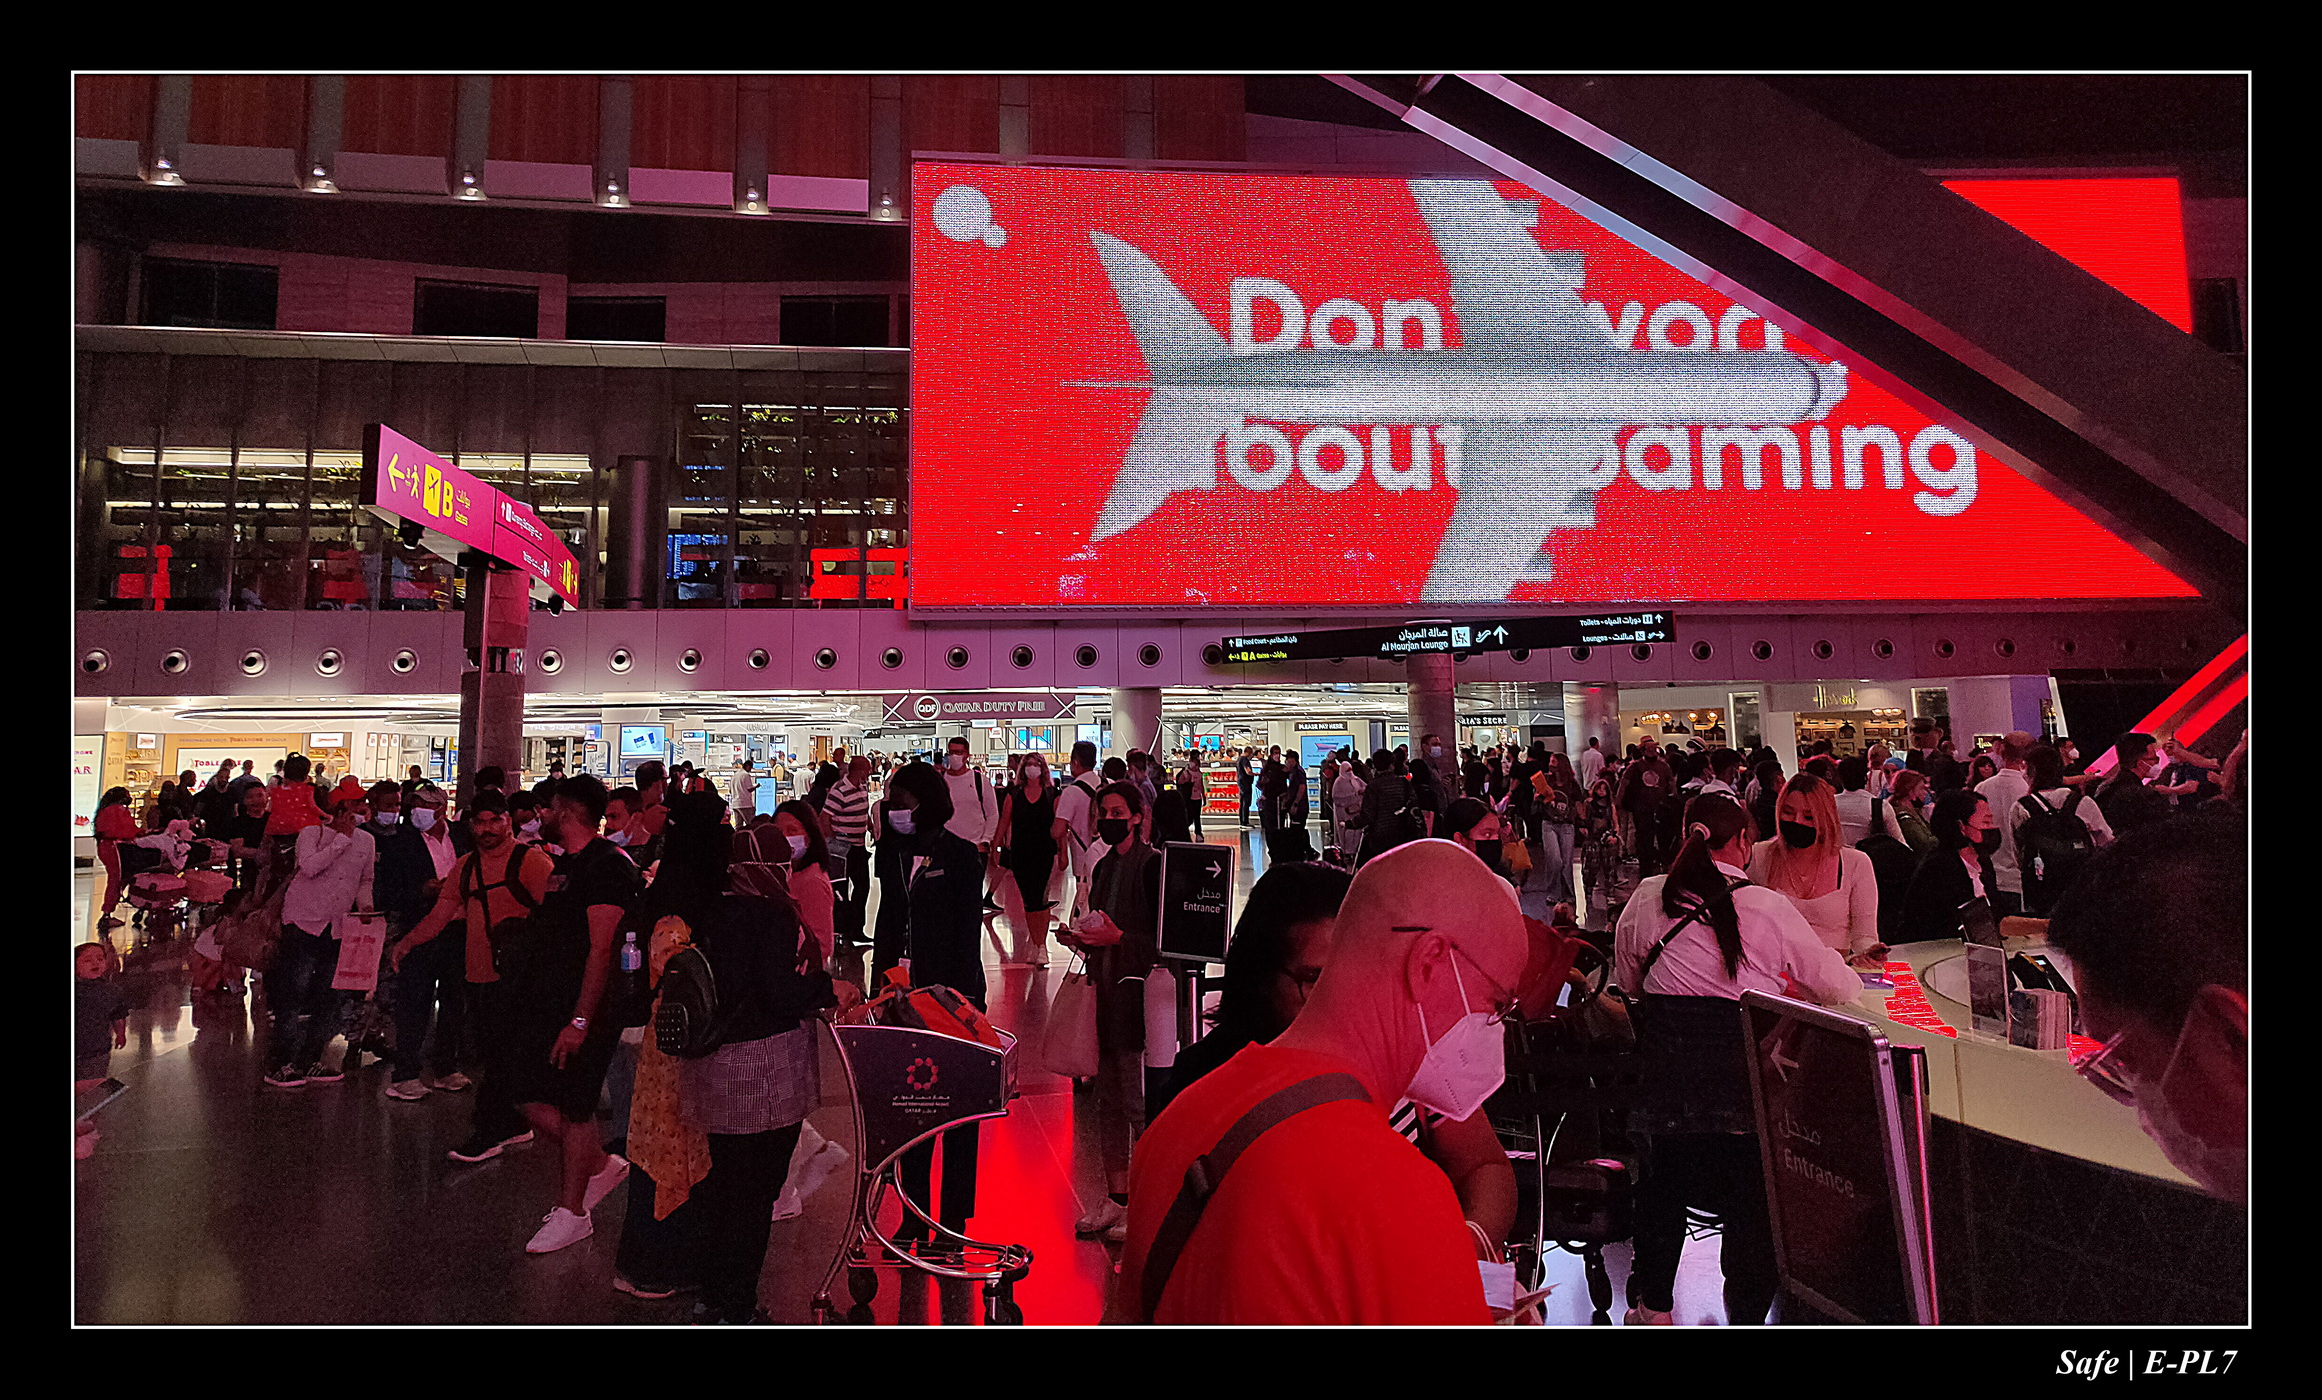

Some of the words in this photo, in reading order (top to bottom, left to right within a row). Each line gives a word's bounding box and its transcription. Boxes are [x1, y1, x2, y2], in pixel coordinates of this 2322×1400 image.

[442, 480, 454, 518] B
[1398, 628, 1427, 642] المرجان
[1427, 627, 1449, 639] صالة
[1582, 635, 1608, 643] Lounges
[1381, 642, 1390, 652] Al
[1390, 641, 1420, 653] Mourjan
[1420, 639, 1449, 651] Lounge
[1249, 651, 1257, 661] A
[918, 704, 936, 714] QDF
[943, 702, 983, 713] QATAR
[984, 702, 1017, 712] DUTY
[1018, 701, 1046, 711] FREE
[1329, 722, 1345, 730] HERE
[1197, 886, 1221, 901] مدخل
[1183, 901, 1222, 914] Entrance
[1784, 1147, 1855, 1199] Entrance
